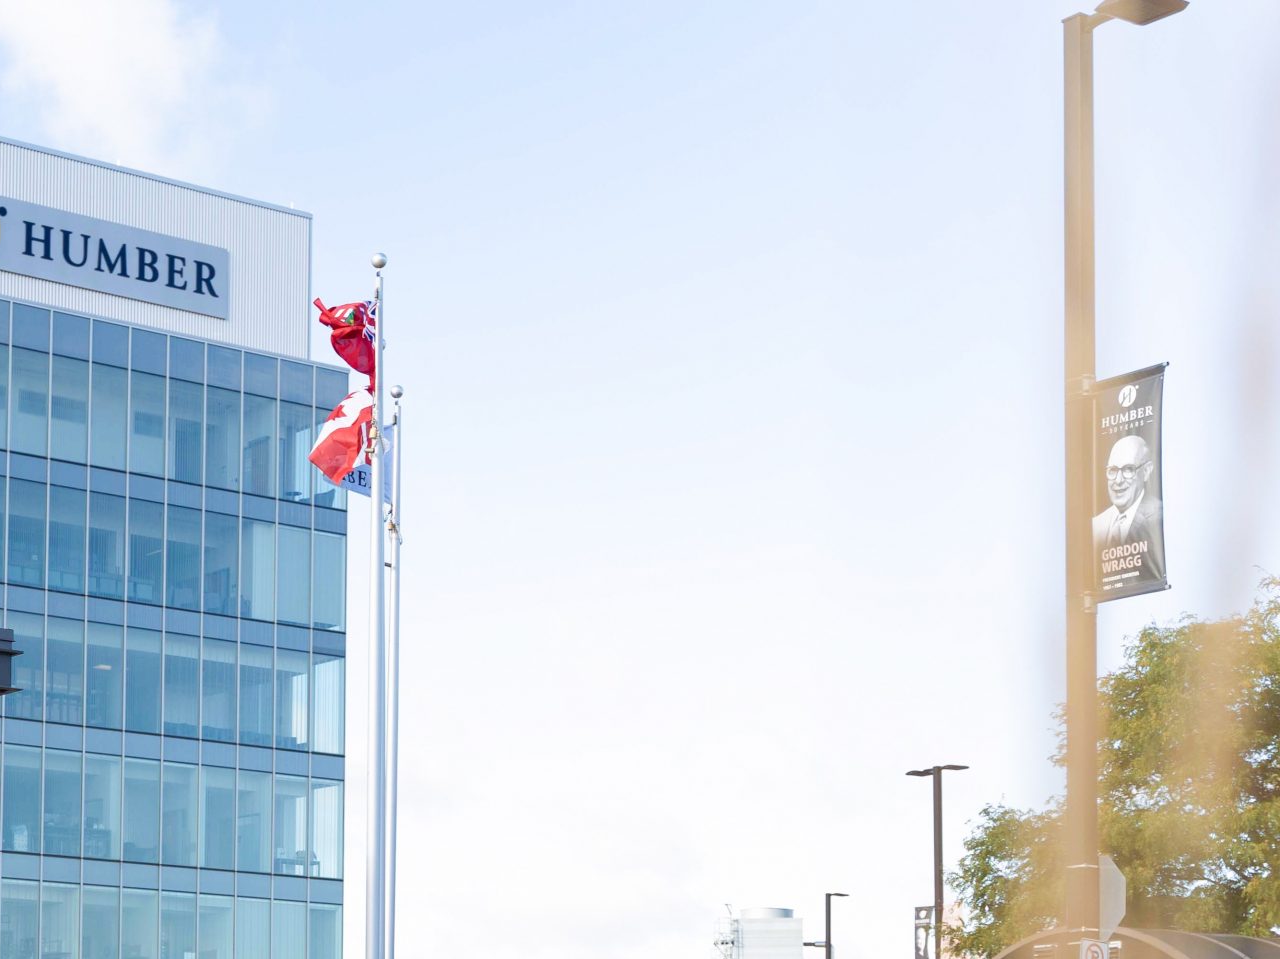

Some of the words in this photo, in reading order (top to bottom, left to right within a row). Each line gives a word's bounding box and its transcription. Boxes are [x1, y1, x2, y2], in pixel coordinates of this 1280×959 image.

[22, 220, 219, 298] HUMBER
[1101, 405, 1154, 429] HUMBER
[1120, 419, 1145, 432] YEARS
[1102, 540, 1148, 561] GORDON
[1102, 554, 1142, 573] WRAGG
